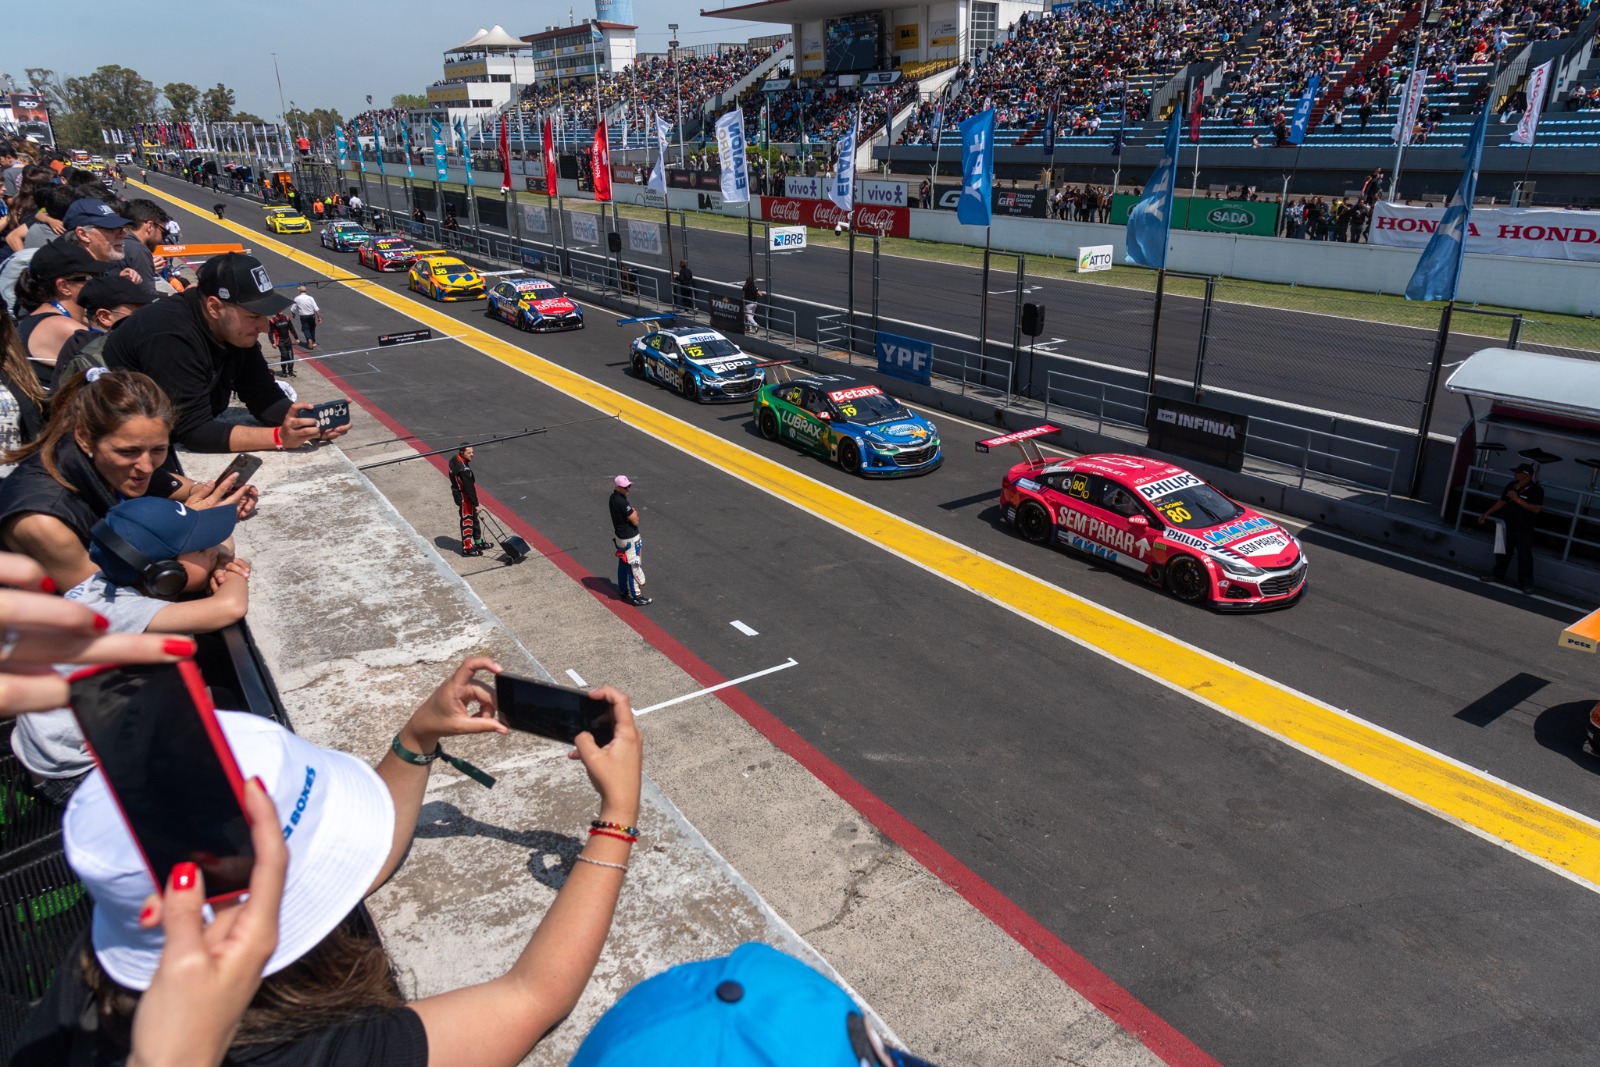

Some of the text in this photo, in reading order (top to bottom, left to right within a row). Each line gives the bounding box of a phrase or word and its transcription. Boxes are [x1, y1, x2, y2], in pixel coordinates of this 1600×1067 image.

[788, 180, 809, 195] vivo
[867, 184, 893, 202] vivo
[1211, 210, 1249, 225] SADA
[1375, 215, 1481, 237] HONA
[784, 233, 804, 246] BRB
[1088, 253, 1112, 266] ATTO
[711, 299, 740, 313] TANCO
[697, 334, 717, 342] BRB
[687, 347, 705, 357] 12
[880, 342, 928, 371] YPF
[831, 387, 880, 402] Betano
[842, 407, 858, 417] 19
[781, 410, 823, 440] LUBRAX
[1177, 413, 1236, 440] INFINIA
[1076, 462, 1128, 477] CHEVROLET
[1072, 480, 1085, 492] 80
[1139, 473, 1200, 499] PHILIPS
[1166, 507, 1192, 523] 80
[1057, 506, 1136, 554] SEM PARAR
[1166, 529, 1210, 551] PHILIPS
[1238, 542, 1255, 556] SEM
[290, 765, 316, 827] BOXES
